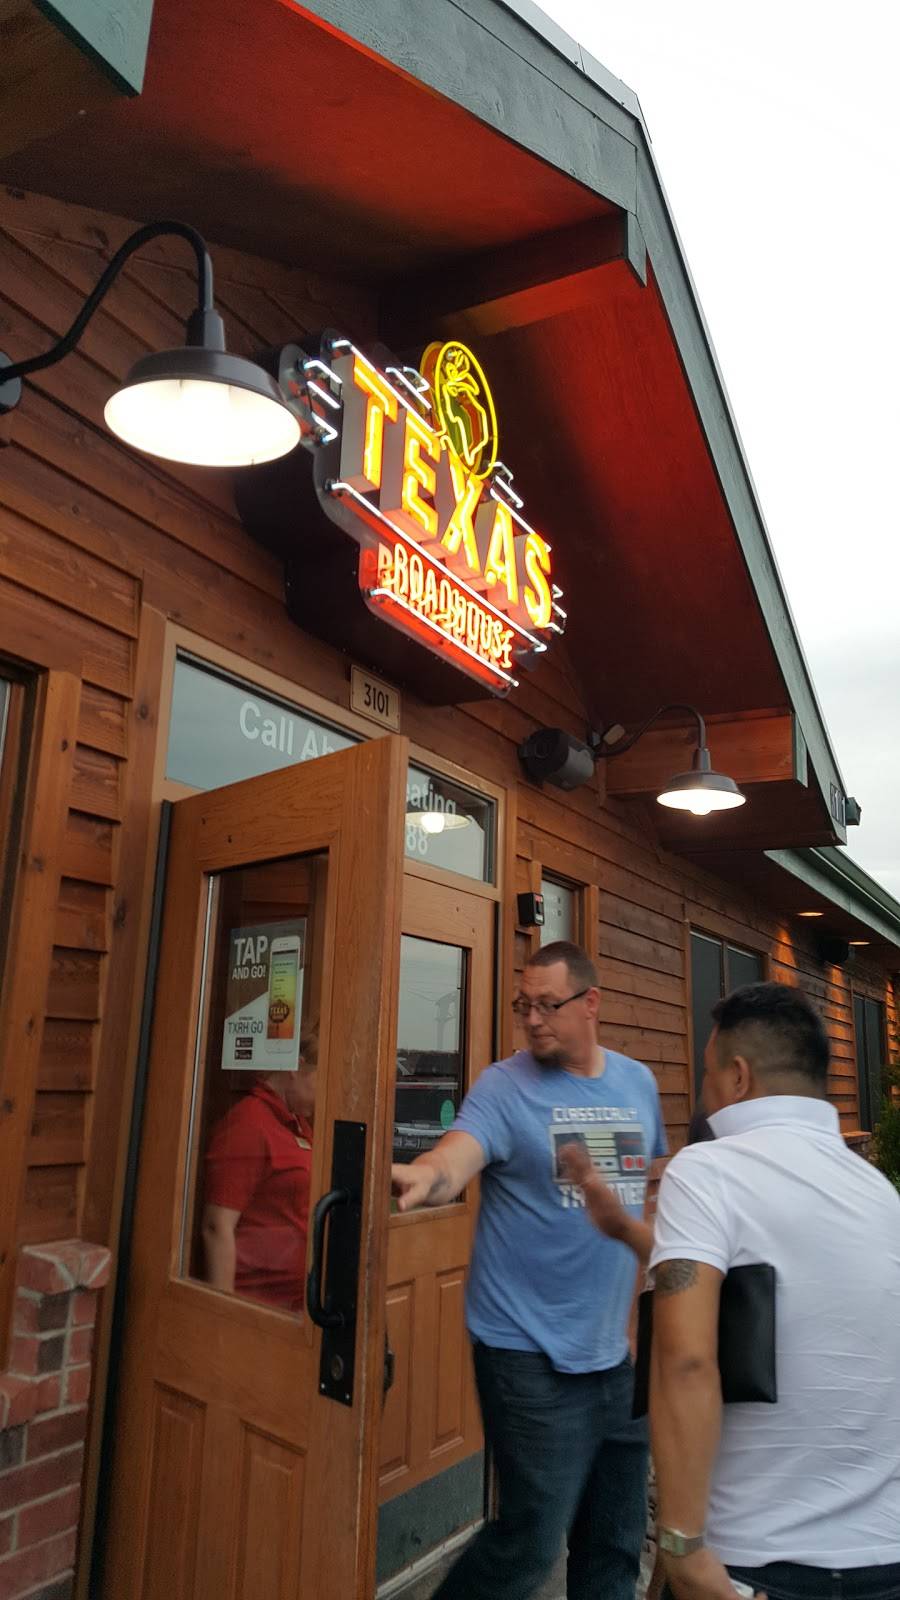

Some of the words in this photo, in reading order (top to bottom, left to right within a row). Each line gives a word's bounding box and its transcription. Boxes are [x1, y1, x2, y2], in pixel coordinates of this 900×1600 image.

[352, 353, 551, 628] TEXAS
[364, 682, 389, 717] 3101
[240, 701, 294, 756] Call
[300, 728, 336, 760] Ah
[234, 935, 268, 966] TAP
[232, 967, 249, 980] AND
[251, 965, 266, 978] GO!
[250, 1020, 264, 1034] GO
